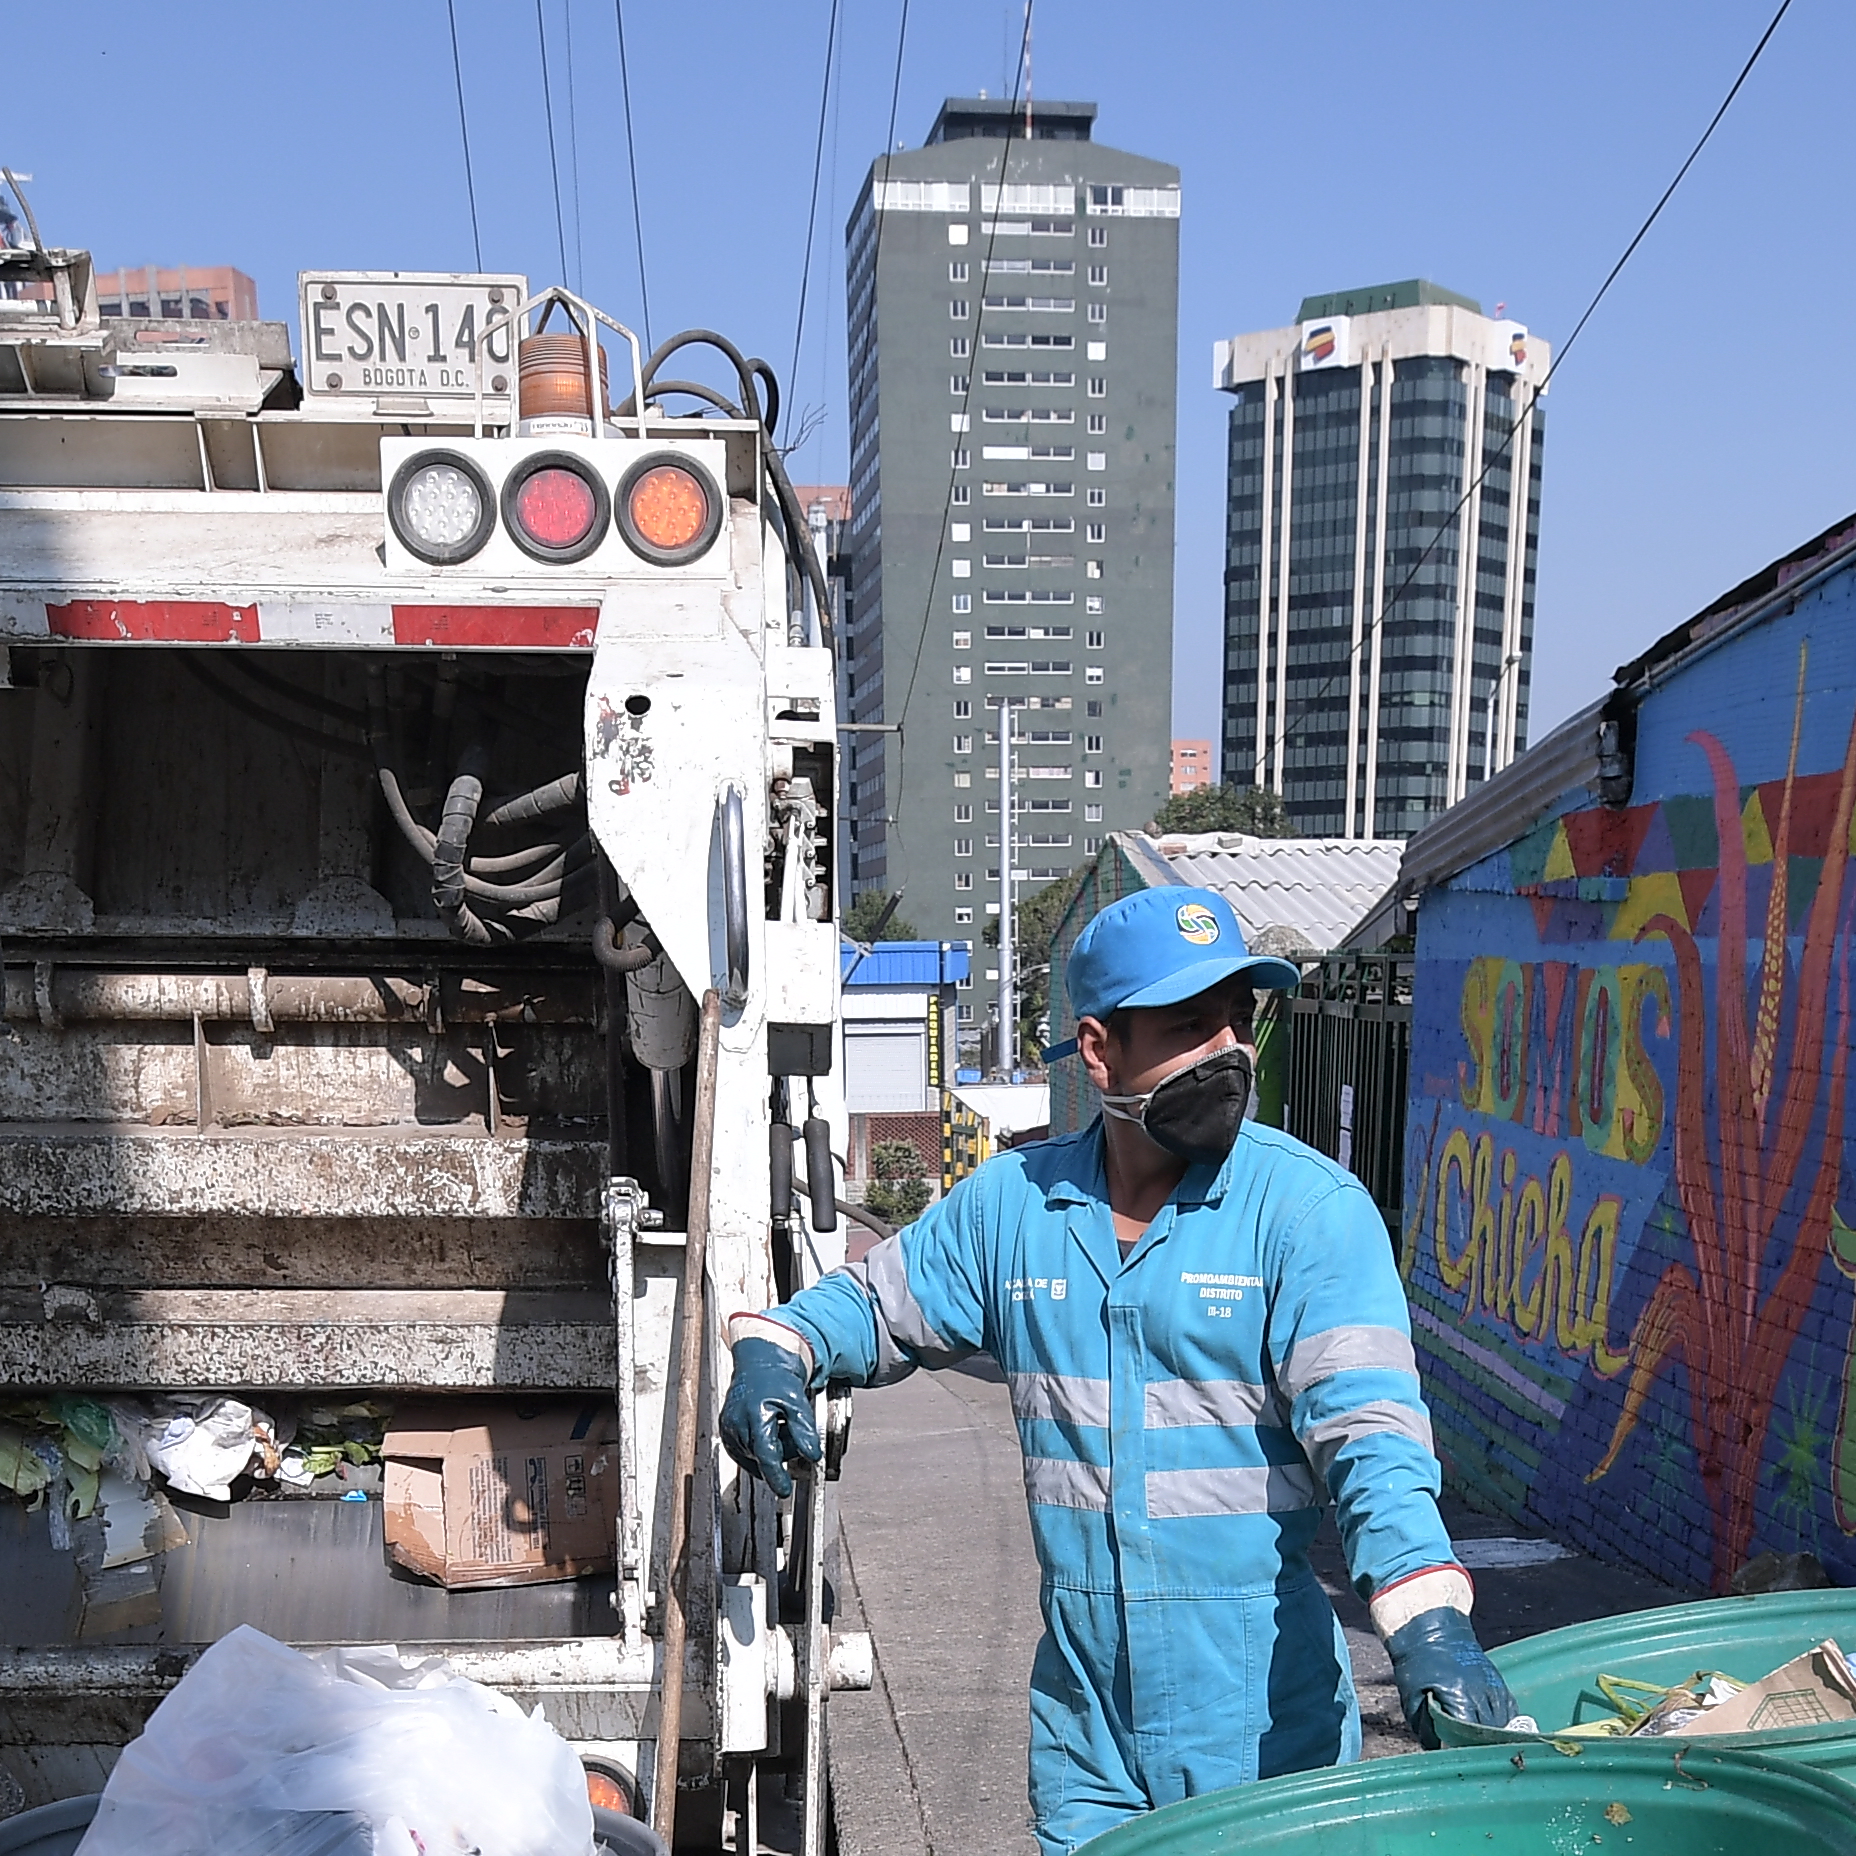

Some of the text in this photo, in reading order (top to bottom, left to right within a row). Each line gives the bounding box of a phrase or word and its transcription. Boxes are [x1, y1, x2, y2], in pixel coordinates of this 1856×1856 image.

[313, 301, 407, 364] ESN
[363, 368, 470, 387] BOGOTA D.C.
[1460, 955, 1672, 1165] SOMOS
[1199, 1286, 1243, 1301] DISTRITO
